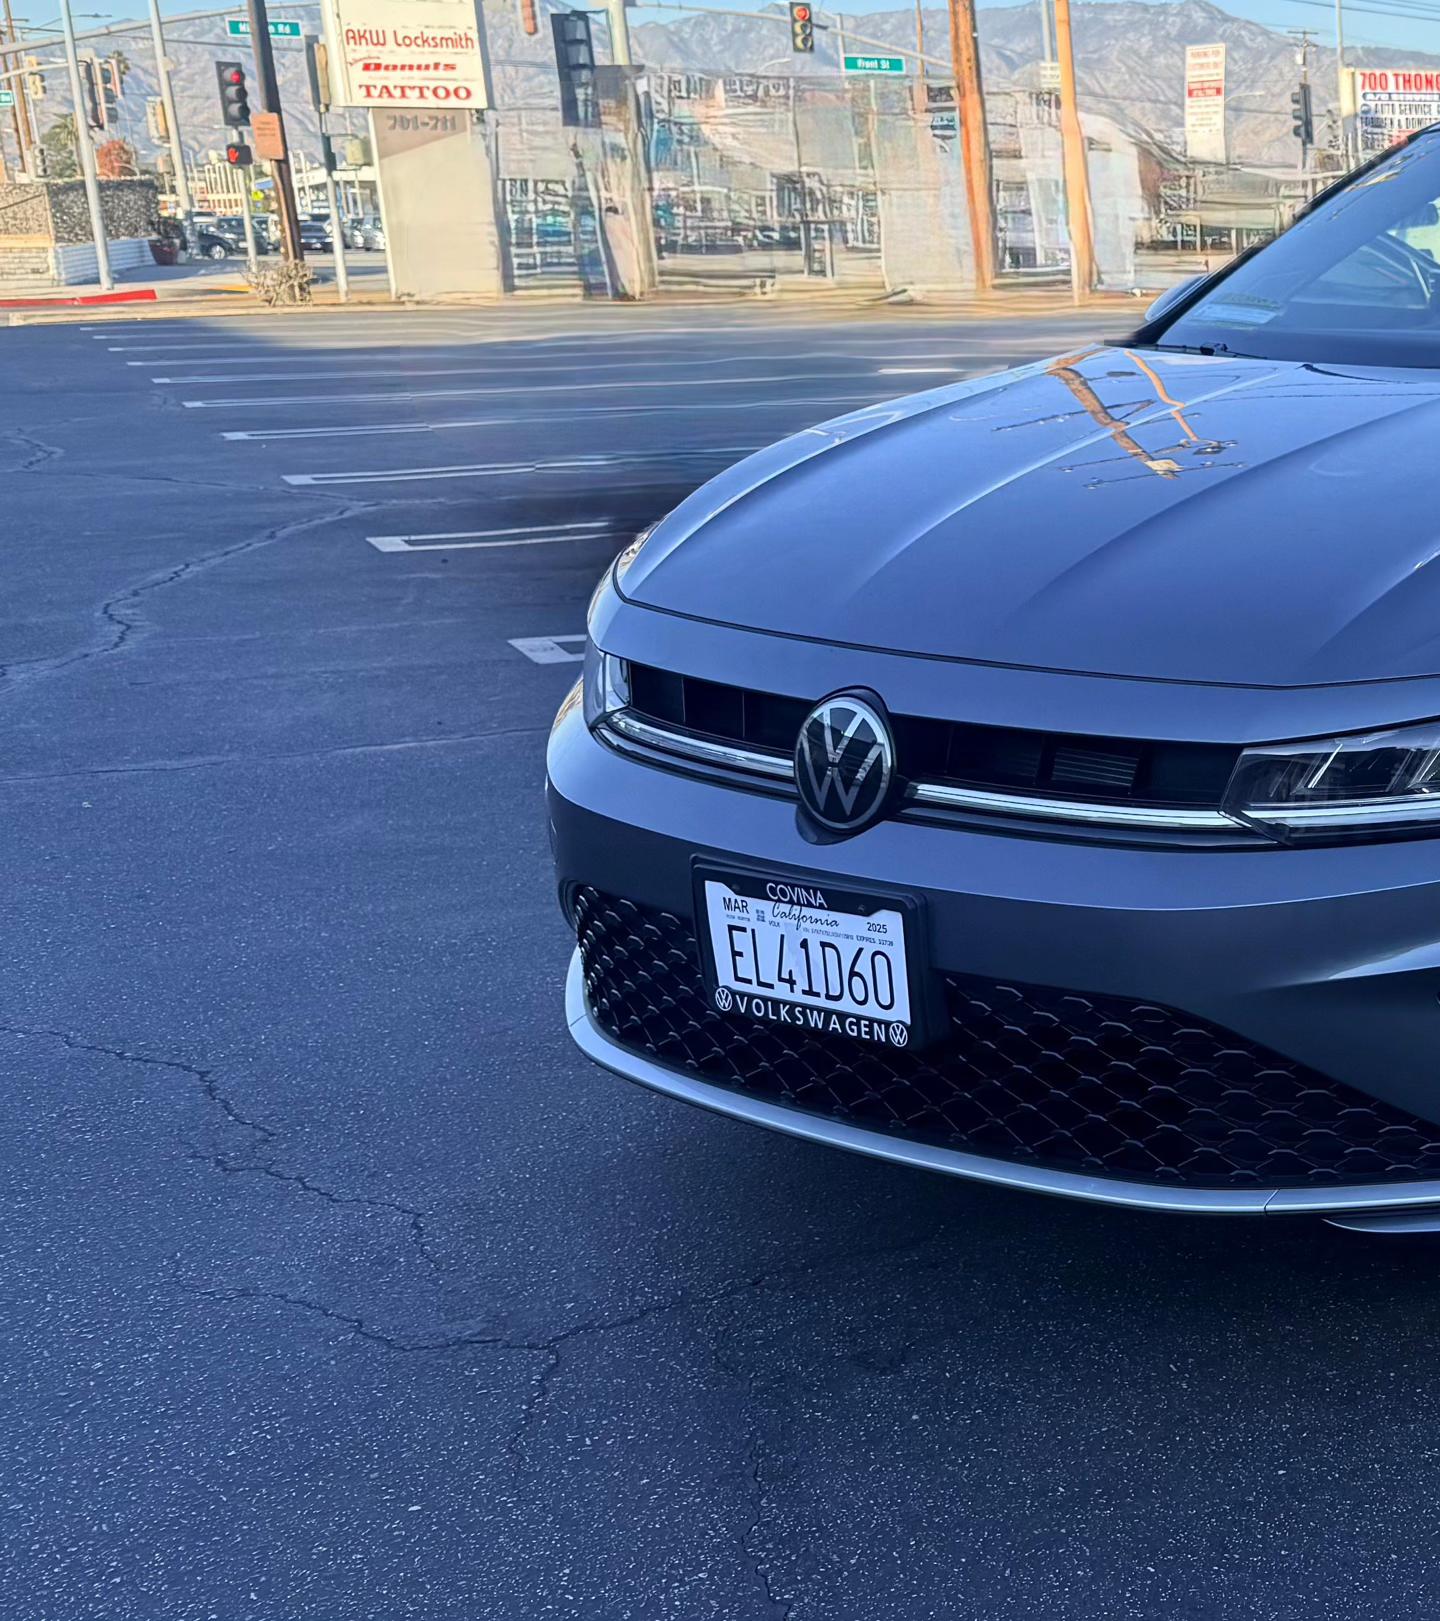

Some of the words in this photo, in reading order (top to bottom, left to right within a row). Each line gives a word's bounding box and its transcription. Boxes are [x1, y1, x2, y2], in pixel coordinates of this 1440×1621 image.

[277, 23, 291, 34] Rd
[345, 29, 386, 46] AKW
[393, 30, 475, 49] Locksmith
[362, 62, 457, 72] Donuts
[358, 84, 472, 100] TATTOO
[1360, 72, 1389, 91] 700
[766, 883, 828, 909] COVINA
[722, 897, 750, 914] MAR
[867, 922, 888, 934] 2025
[771, 901, 840, 931] California
[727, 924, 896, 1010] EL41D60
[736, 995, 886, 1042] VOLKSWAGEN
